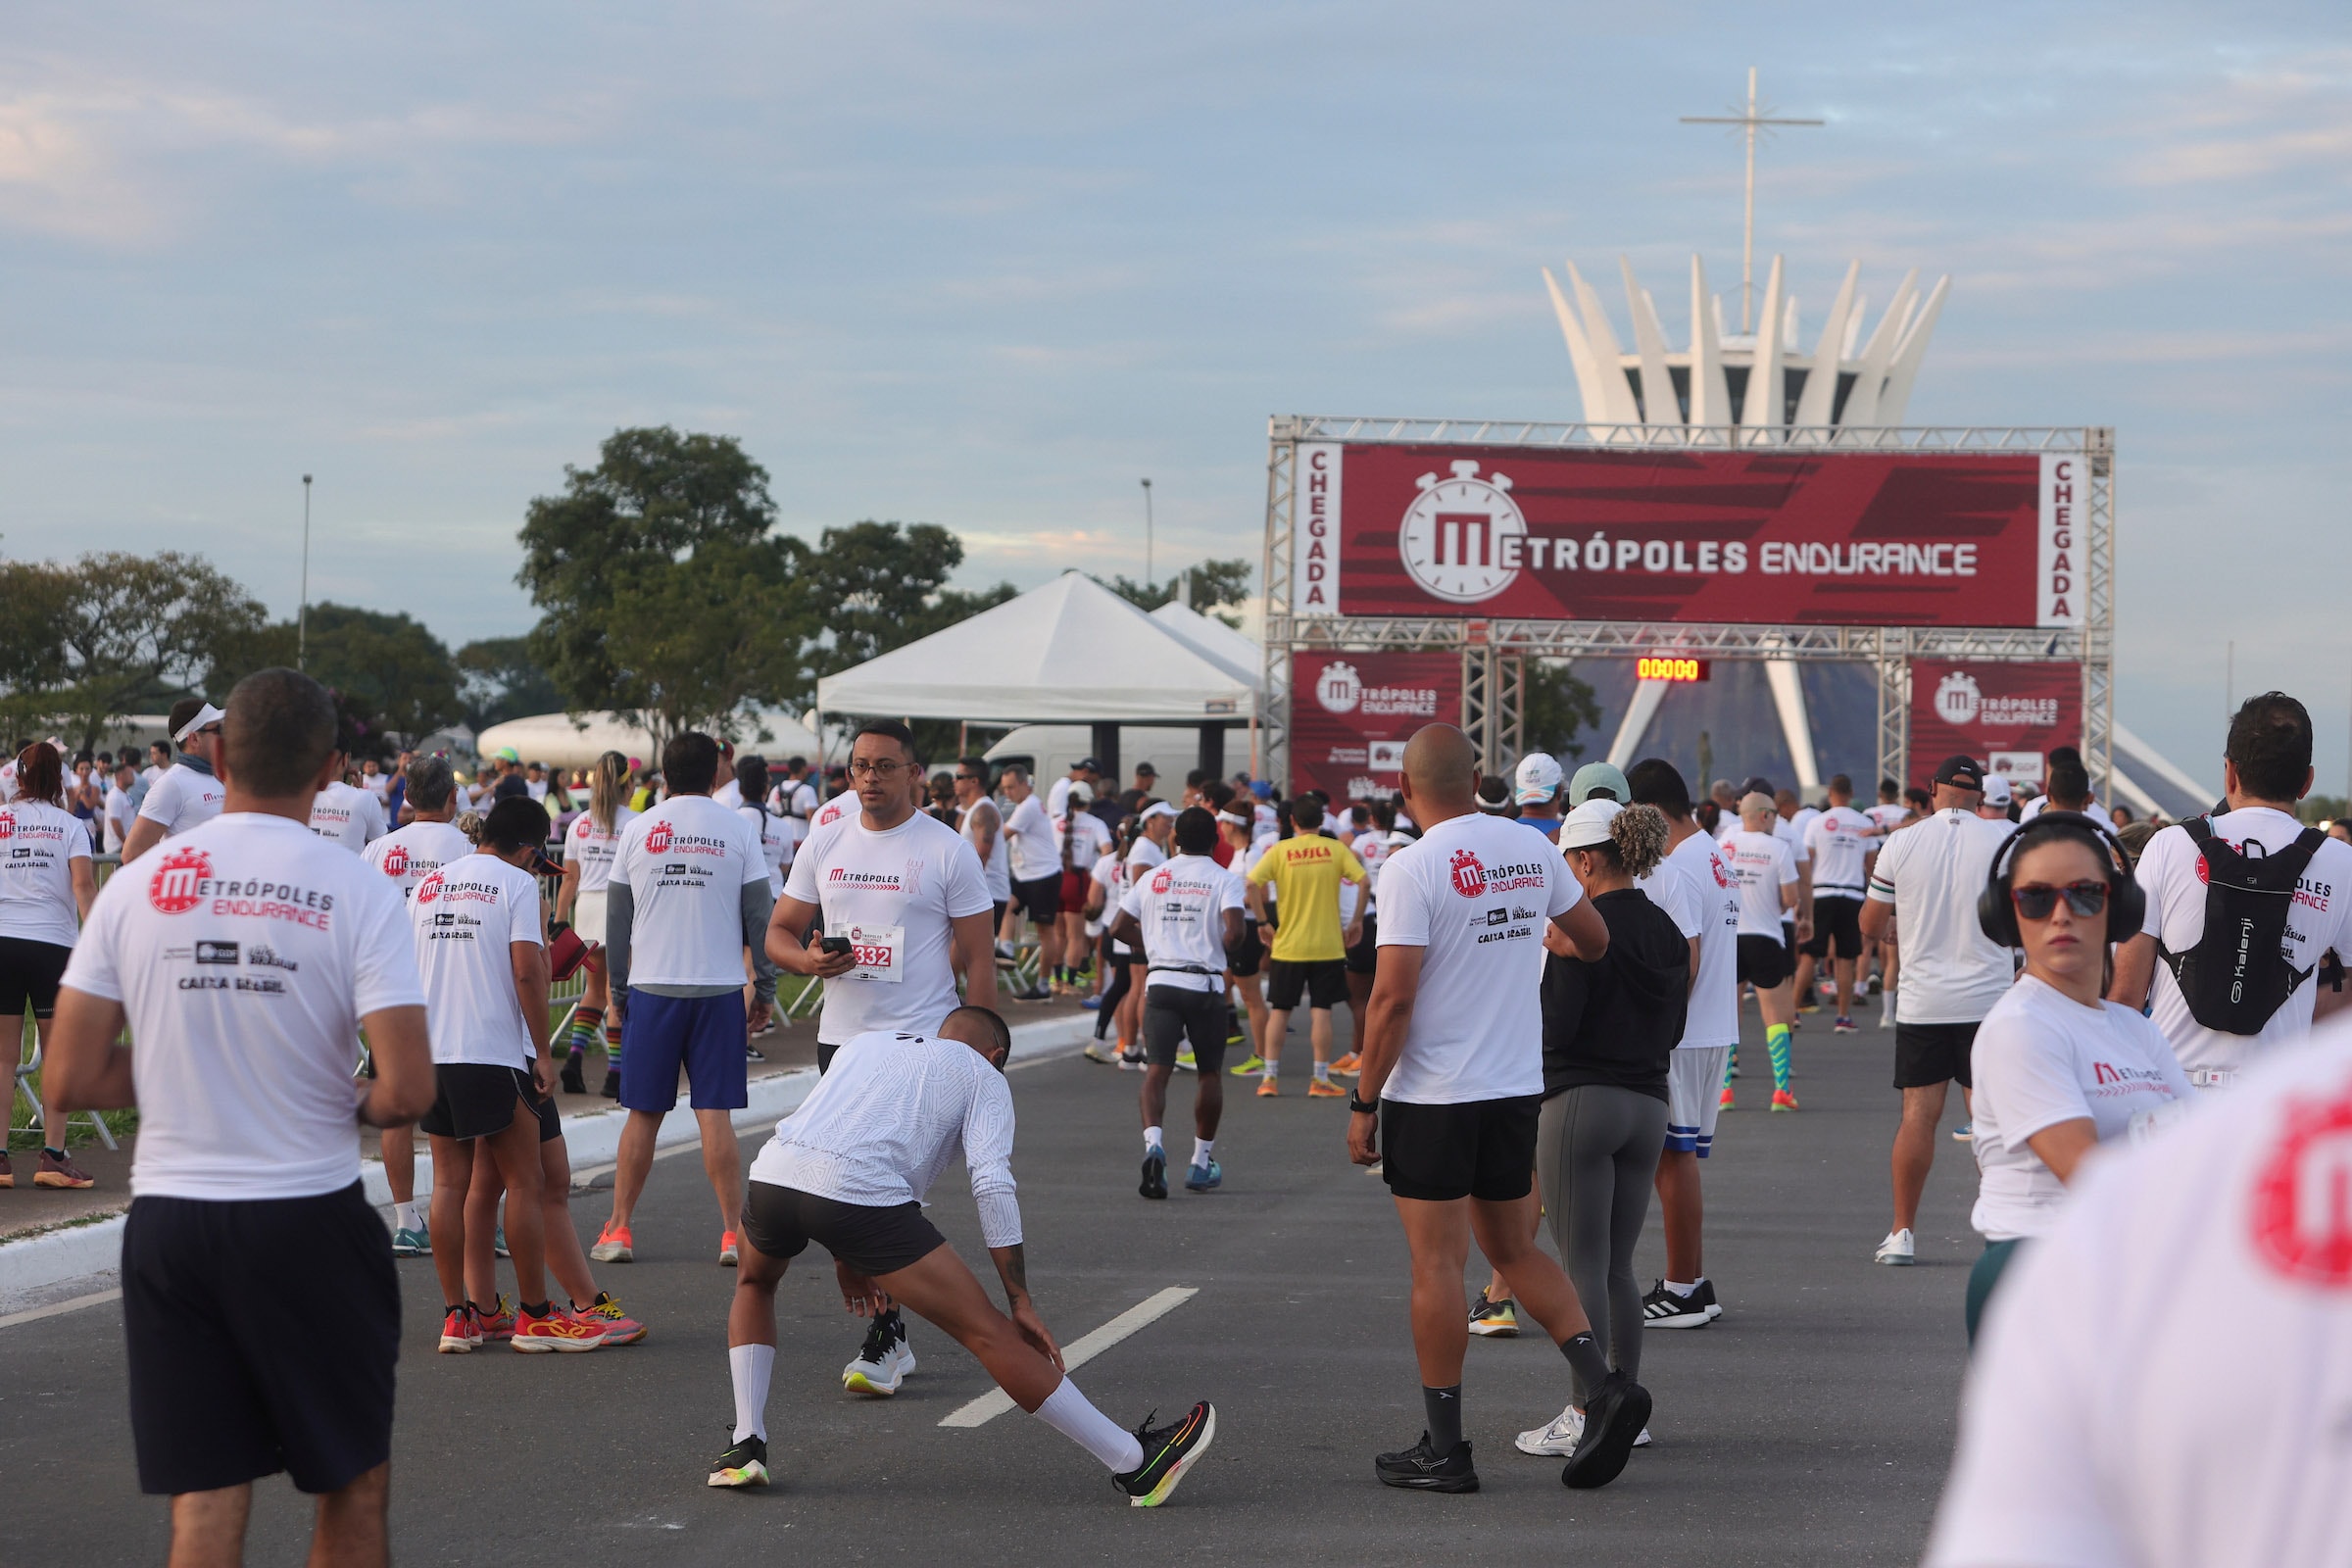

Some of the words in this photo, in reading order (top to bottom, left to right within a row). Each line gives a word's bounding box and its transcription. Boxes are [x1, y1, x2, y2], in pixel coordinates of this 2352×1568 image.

[1306, 451, 1328, 605] CHEGADA
[1435, 513, 1747, 574] METRÓPOLES
[1760, 542, 1978, 576] ENDURANCE
[2052, 461, 2072, 617] CHEGADA
[1330, 681, 1437, 702] METRÓPOLES
[1361, 700, 1437, 716] ENDURANCE
[1947, 691, 2057, 711] METRÓPOLES
[1981, 710, 2057, 725] ENDURANCE
[313, 807, 351, 816] TRÓPOLES
[18, 832, 63, 841] ENDURANCE
[651, 831, 725, 849] METRÓPOLES
[673, 845, 725, 858] ENDURANCE
[388, 855, 446, 869] METRÓPOL
[829, 868, 900, 884] METRÓPOLES
[1458, 863, 1544, 889] METRÓPOLES
[1491, 876, 1544, 894] ENDURANCE
[161, 867, 334, 910] METRÓPOLES
[422, 879, 499, 897] METRÓPOLES
[443, 891, 497, 905] ENDURANCE
[2291, 891, 2328, 912] RANCE
[212, 899, 330, 931] ENDURANCE
[1478, 931, 1505, 944] CAIXA
[853, 946, 890, 965] 332
[2233, 917, 2254, 977] Kalenji
[178, 976, 230, 991] CAIXA
